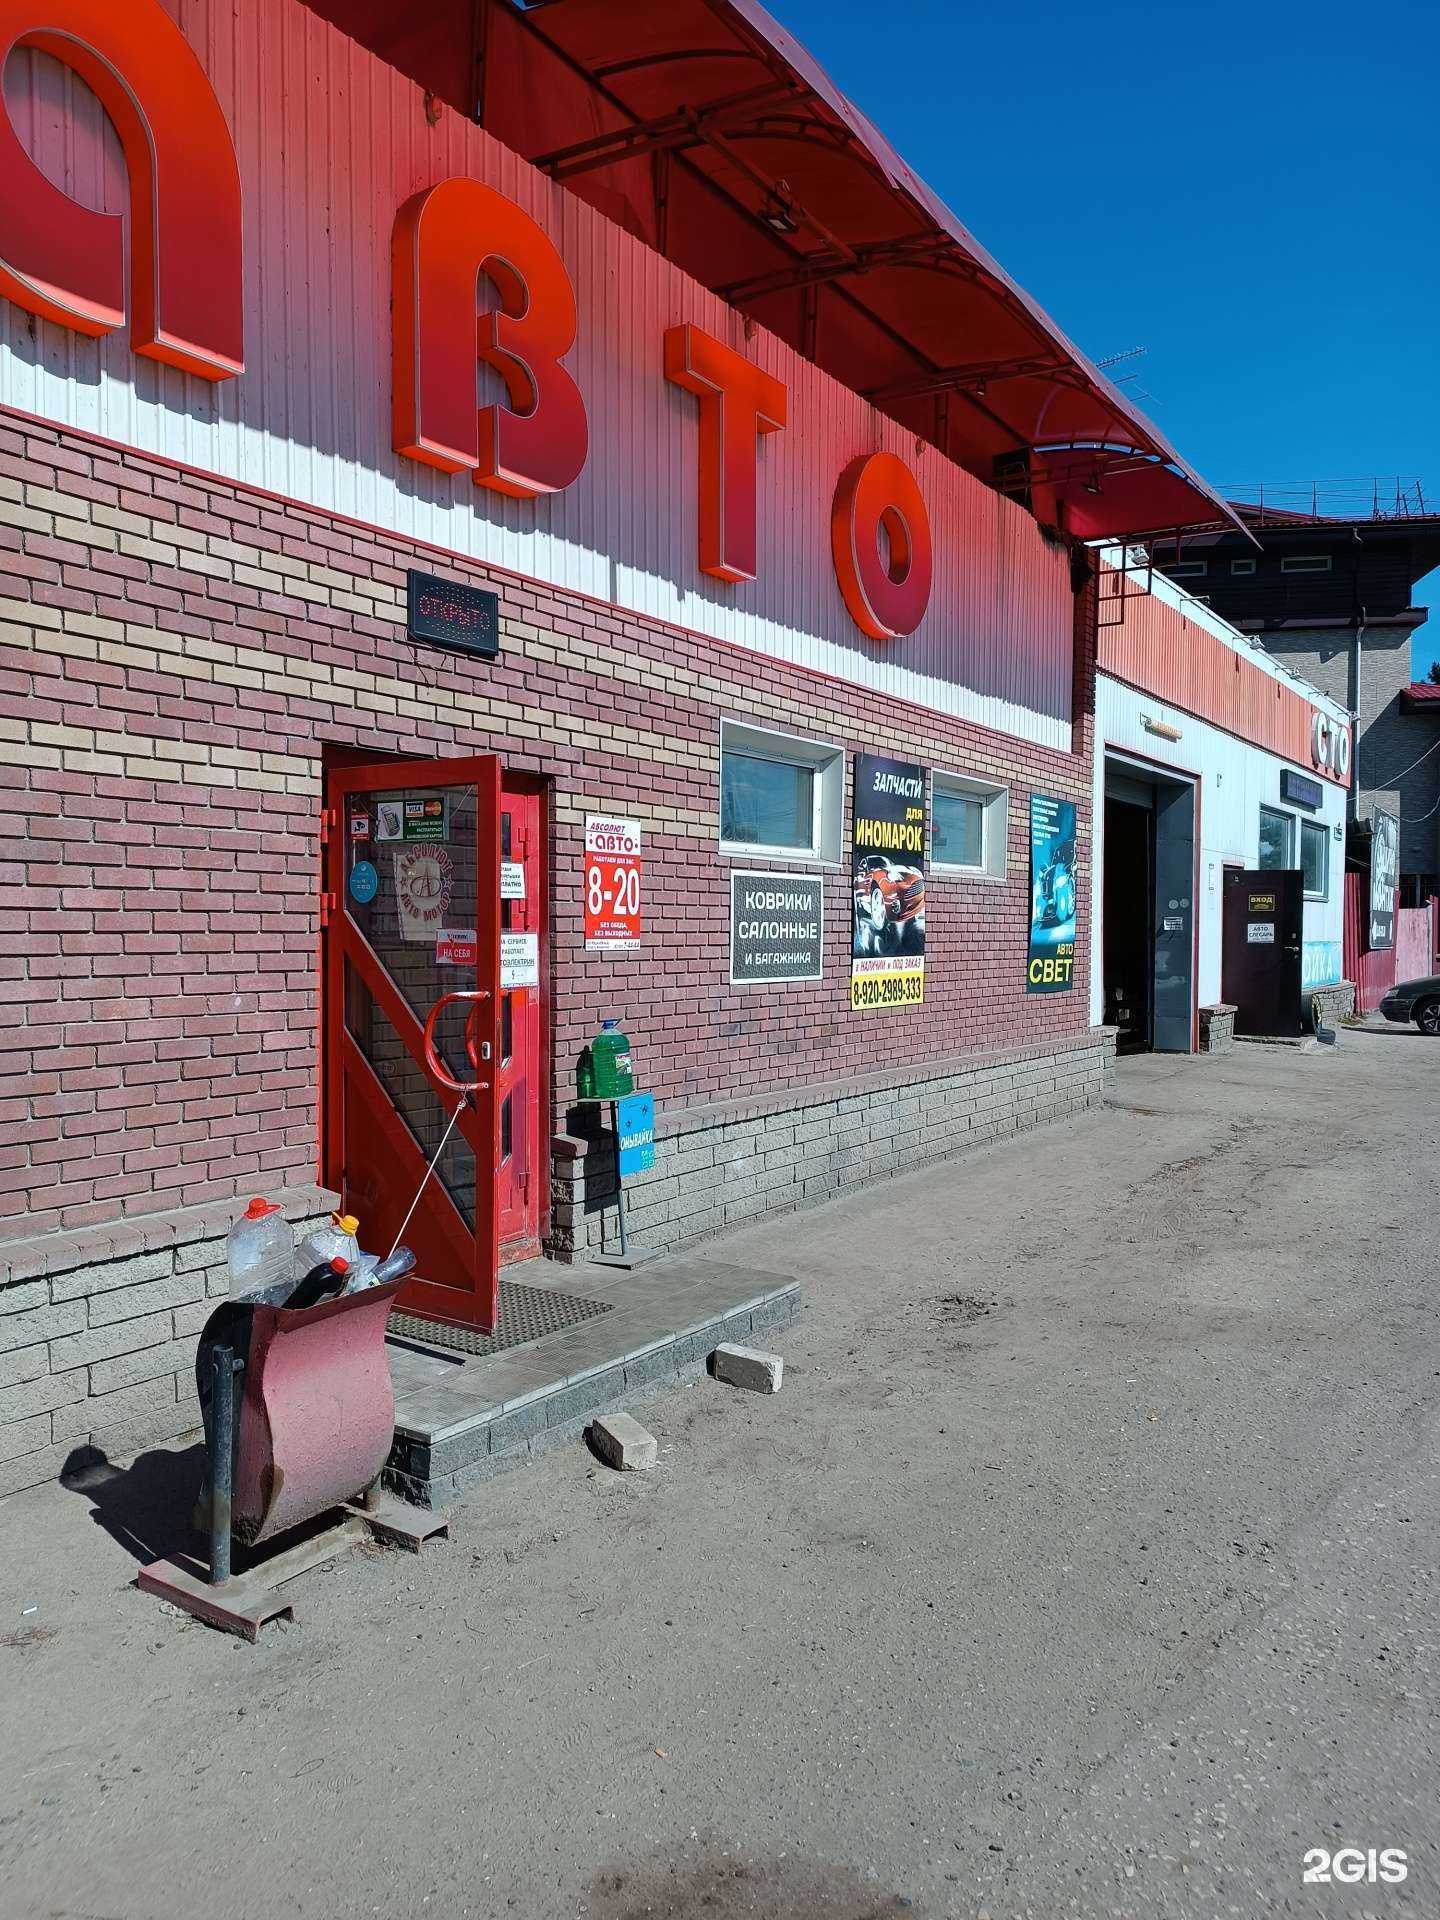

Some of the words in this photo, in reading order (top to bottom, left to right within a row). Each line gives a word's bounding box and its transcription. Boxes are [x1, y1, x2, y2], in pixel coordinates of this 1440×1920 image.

[1311, 712, 1349, 775] СТО
[872, 771, 922, 799] ЗАПЧАСТИ
[590, 821, 625, 834] АБСОЛЮТ
[856, 817, 923, 852] ИНОМАРОК
[588, 866, 640, 916] 8-20
[745, 890, 812, 911] КОВРИКИ
[1250, 896, 1273, 904] ВХОД
[738, 921, 818, 939] САЛОННЫЕ
[745, 953, 752, 965] И
[755, 951, 811, 965] БАГАЖНИКА
[1056, 943, 1073, 955] АВТО
[1029, 958, 1073, 984] СВЕТ
[853, 976, 921, 1006] 8-920-2989-333
